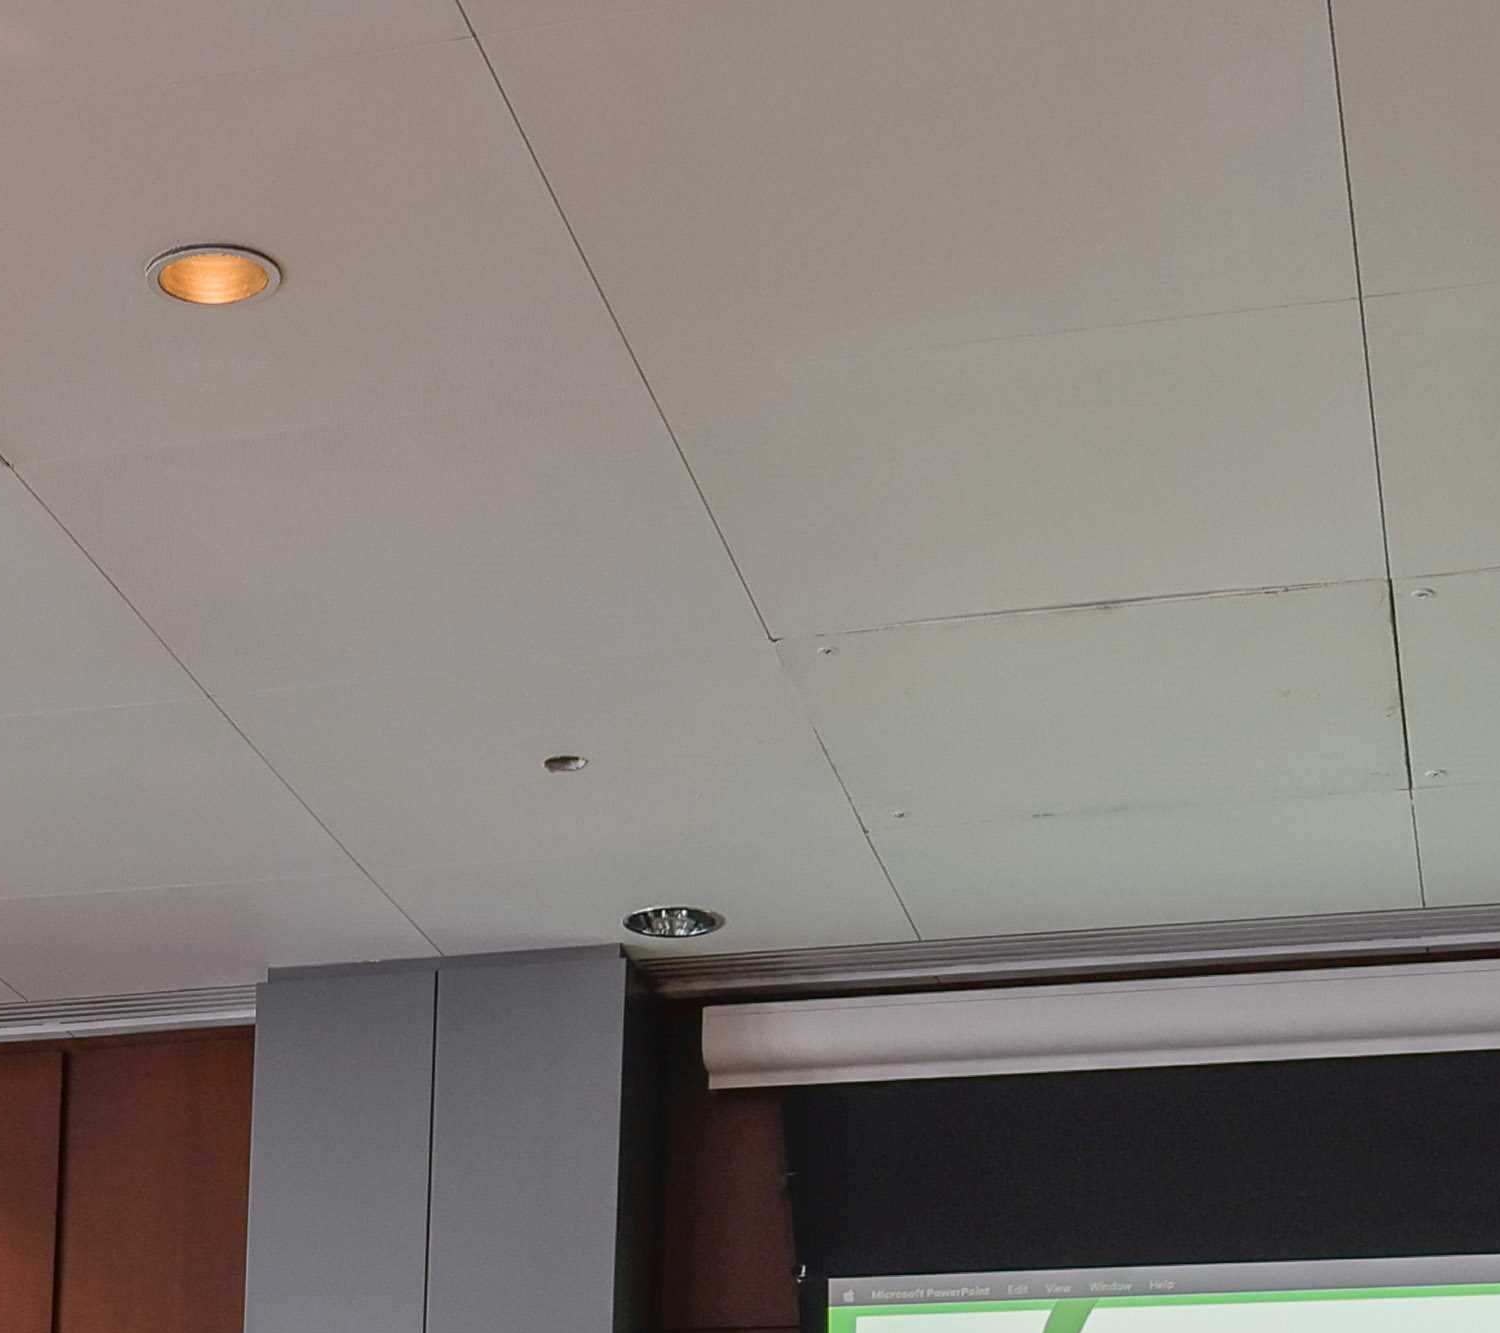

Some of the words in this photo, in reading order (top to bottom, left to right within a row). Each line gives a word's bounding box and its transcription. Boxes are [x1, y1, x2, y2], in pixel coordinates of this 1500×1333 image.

[1007, 1283, 1029, 1295] Edit
[1045, 1282, 1072, 1294] View
[1089, 1280, 1133, 1292] Window
[1149, 1278, 1176, 1291] Help
